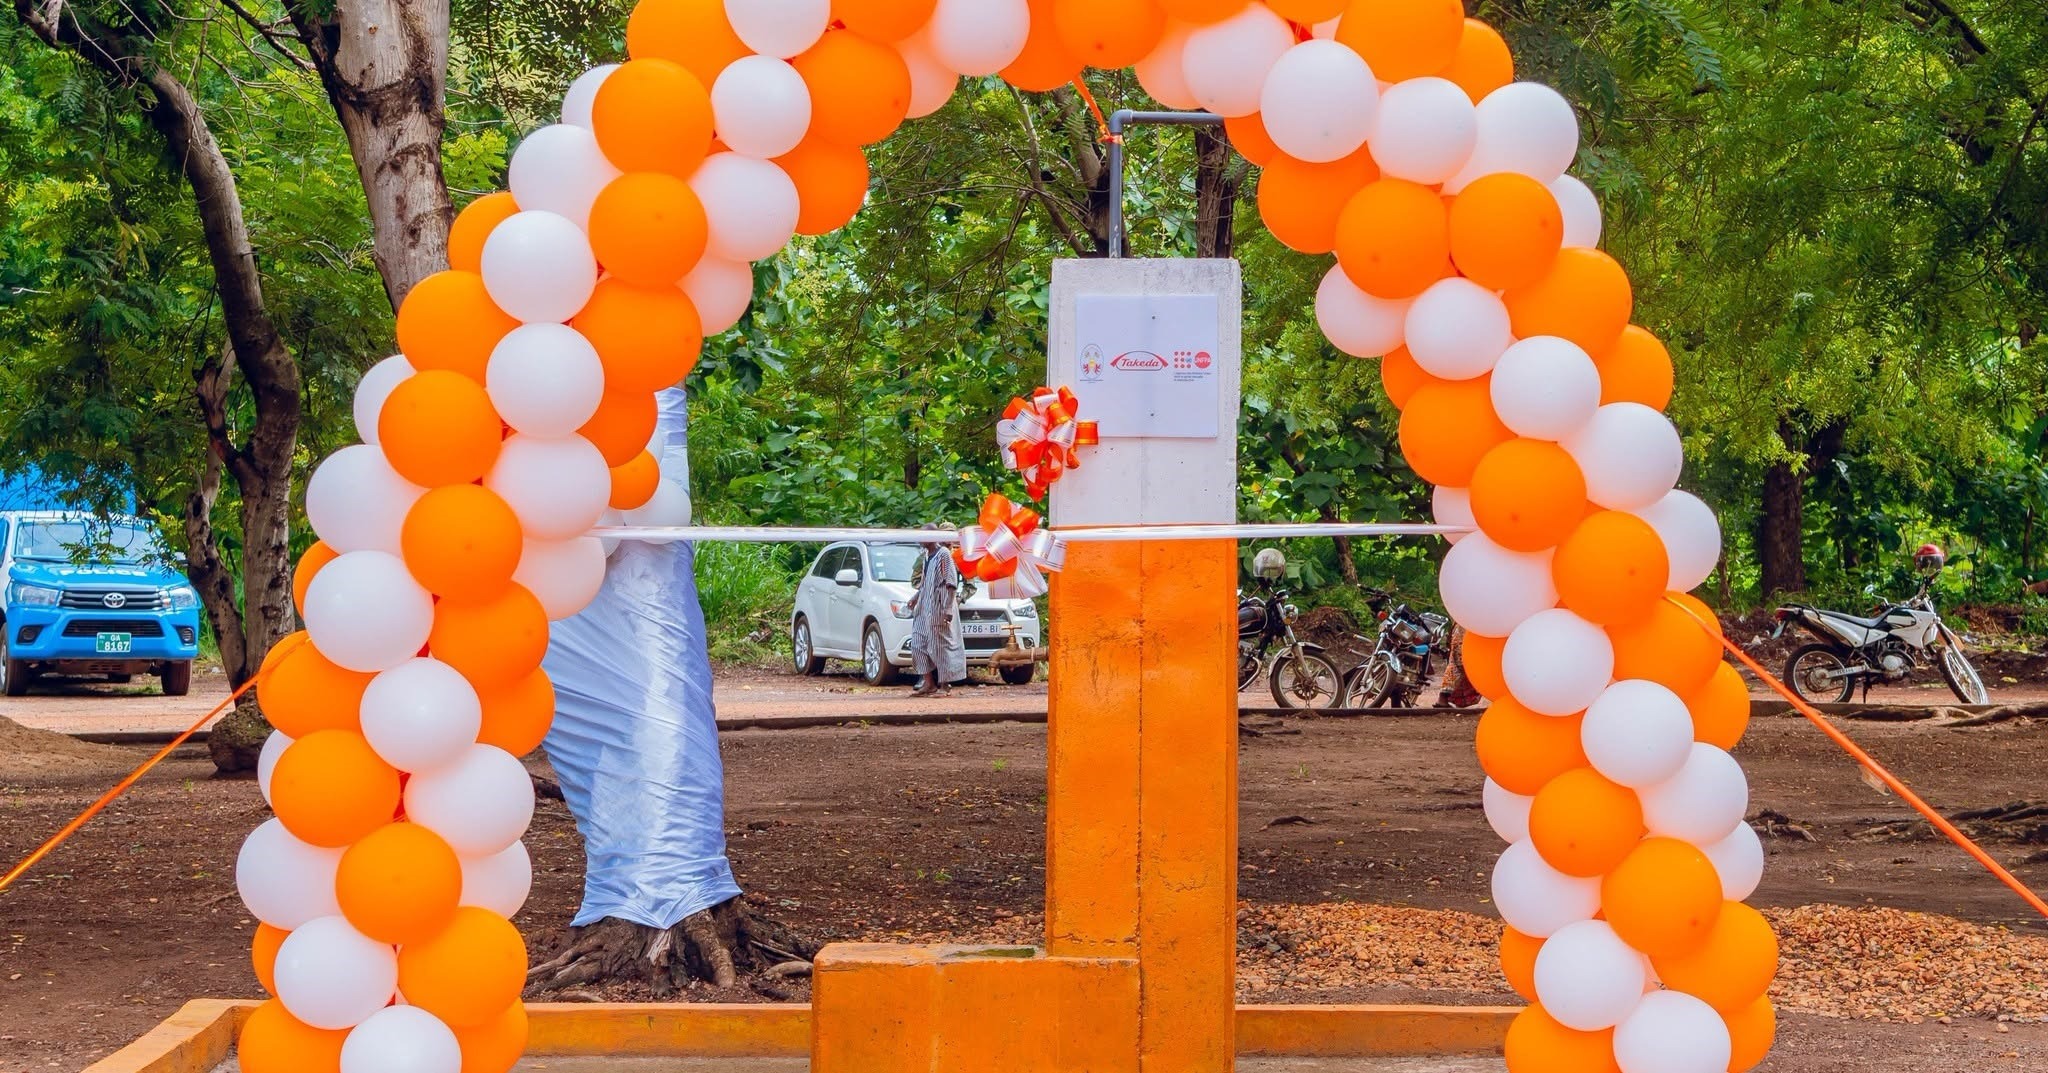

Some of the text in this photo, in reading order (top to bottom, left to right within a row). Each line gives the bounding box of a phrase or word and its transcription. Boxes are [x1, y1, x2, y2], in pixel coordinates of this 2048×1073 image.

[1121, 359, 1159, 367] Takeda
[962, 625, 983, 633] 1786
[990, 625, 998, 633] BI
[104, 641, 130, 651] 8167
